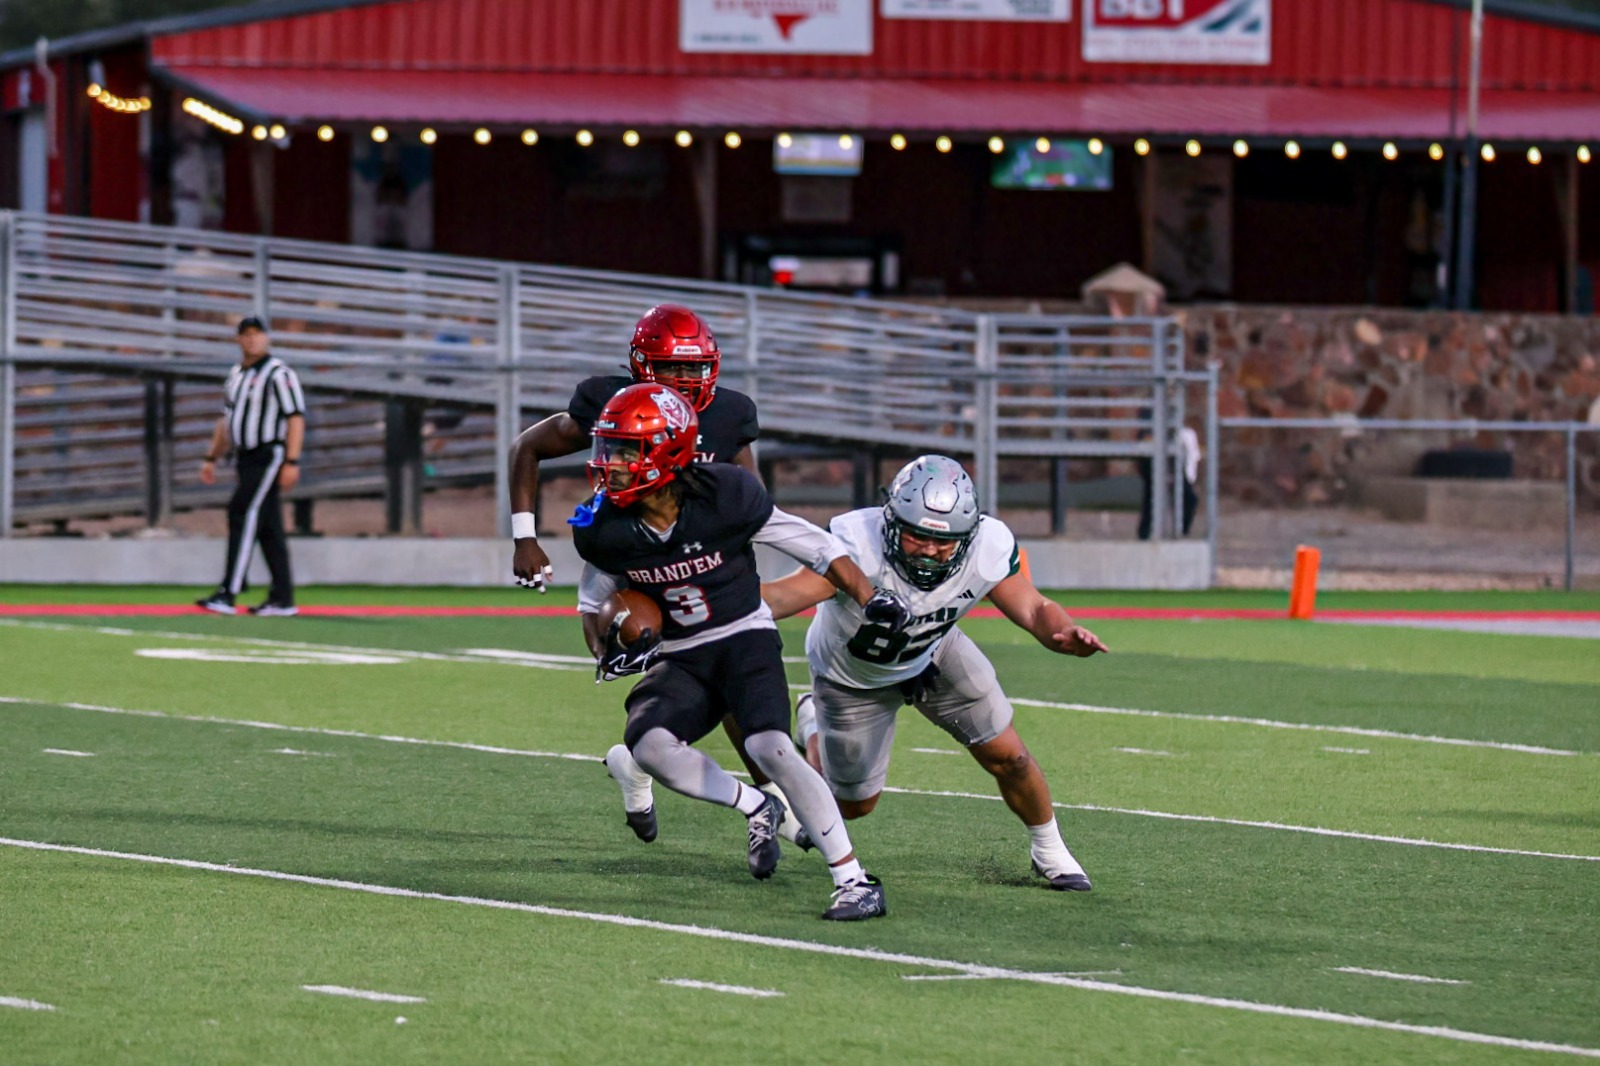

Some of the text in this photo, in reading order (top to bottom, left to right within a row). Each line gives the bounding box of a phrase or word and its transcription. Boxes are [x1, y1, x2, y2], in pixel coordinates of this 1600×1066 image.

[627, 551, 724, 583] BRAND'EM
[663, 584, 712, 627] 3
[847, 620, 957, 664] 82
